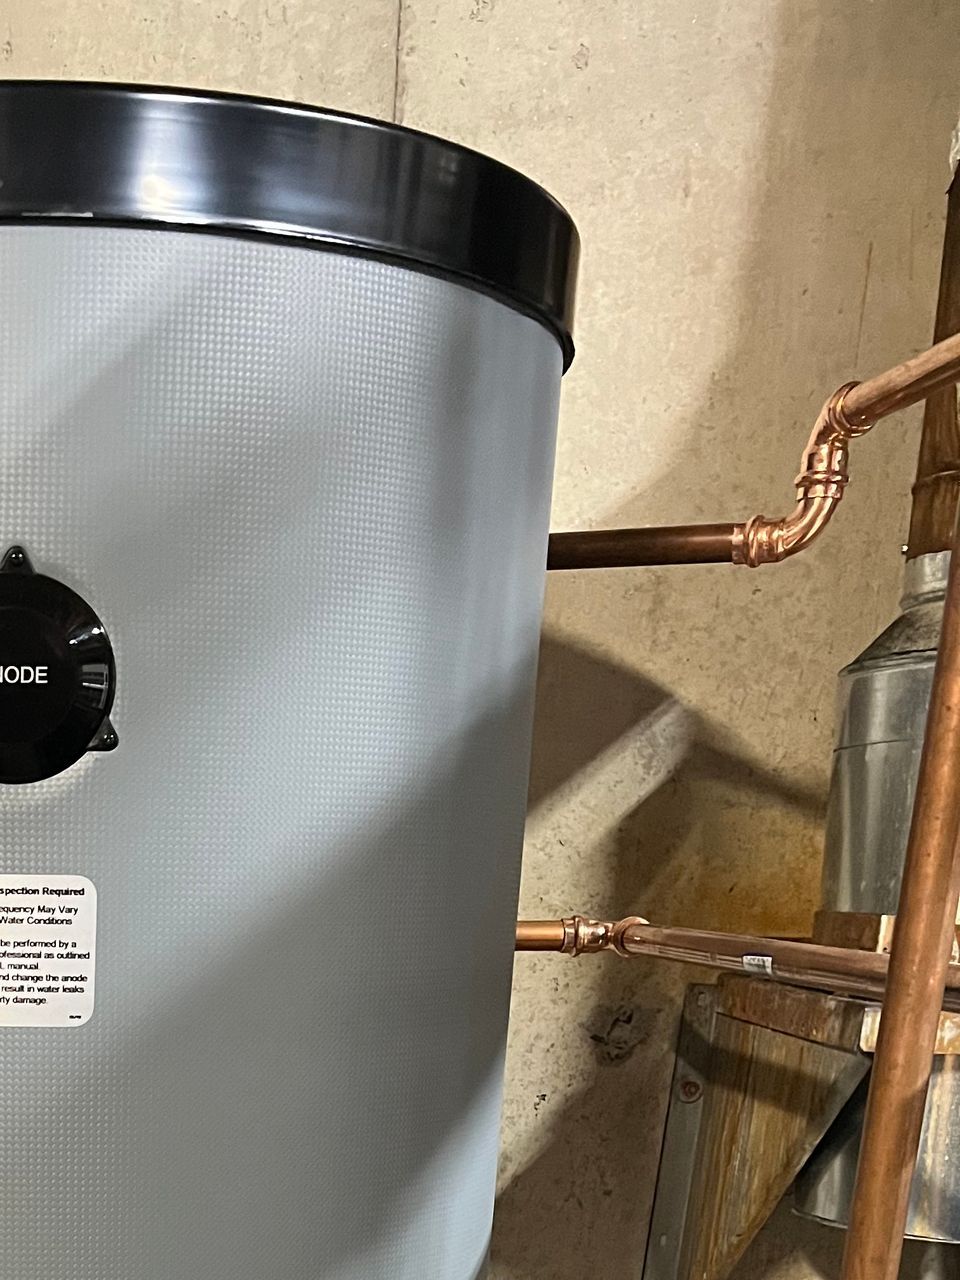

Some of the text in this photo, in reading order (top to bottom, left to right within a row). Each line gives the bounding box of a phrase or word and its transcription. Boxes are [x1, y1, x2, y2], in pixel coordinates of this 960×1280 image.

[42, 887, 85, 897] Required
[38, 905, 56, 915] May
[59, 905, 78, 916] Vary
[27, 916, 72, 925] Conditions
[0, 939, 11, 947] be
[13, 939, 56, 948] performed
[59, 940, 69, 950] by
[12, 973, 44, 983] change
[46, 974, 59, 982] the
[61, 974, 88, 982] anode
[37, 985, 60, 993] water
[62, 985, 85, 993] leaks
